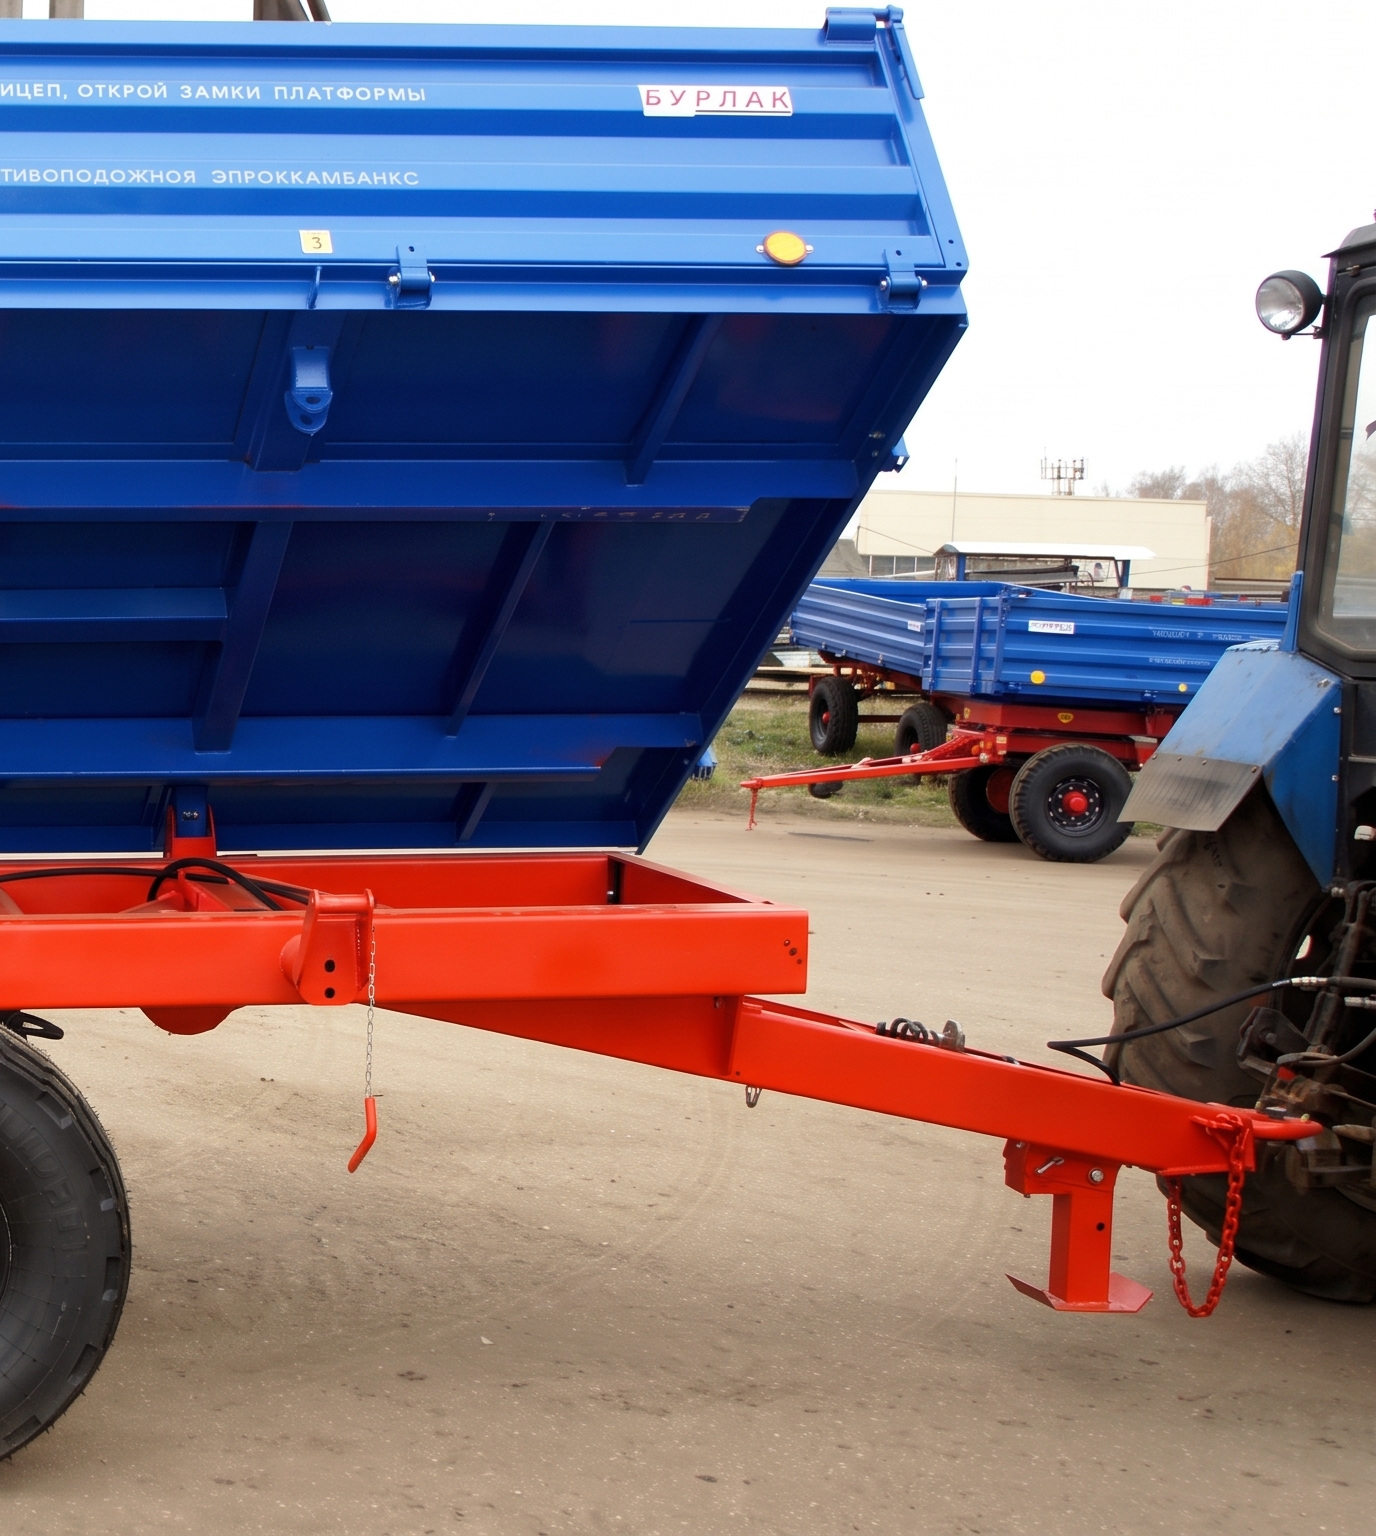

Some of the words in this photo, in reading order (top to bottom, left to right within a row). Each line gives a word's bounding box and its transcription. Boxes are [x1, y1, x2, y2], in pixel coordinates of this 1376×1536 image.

[77, 81, 167, 98] ОТКРОЙ
[180, 85, 261, 100] ЗАМКИ
[274, 86, 426, 102] ПЛАТФОРМЫ
[645, 89, 789, 109] БУРЛАК
